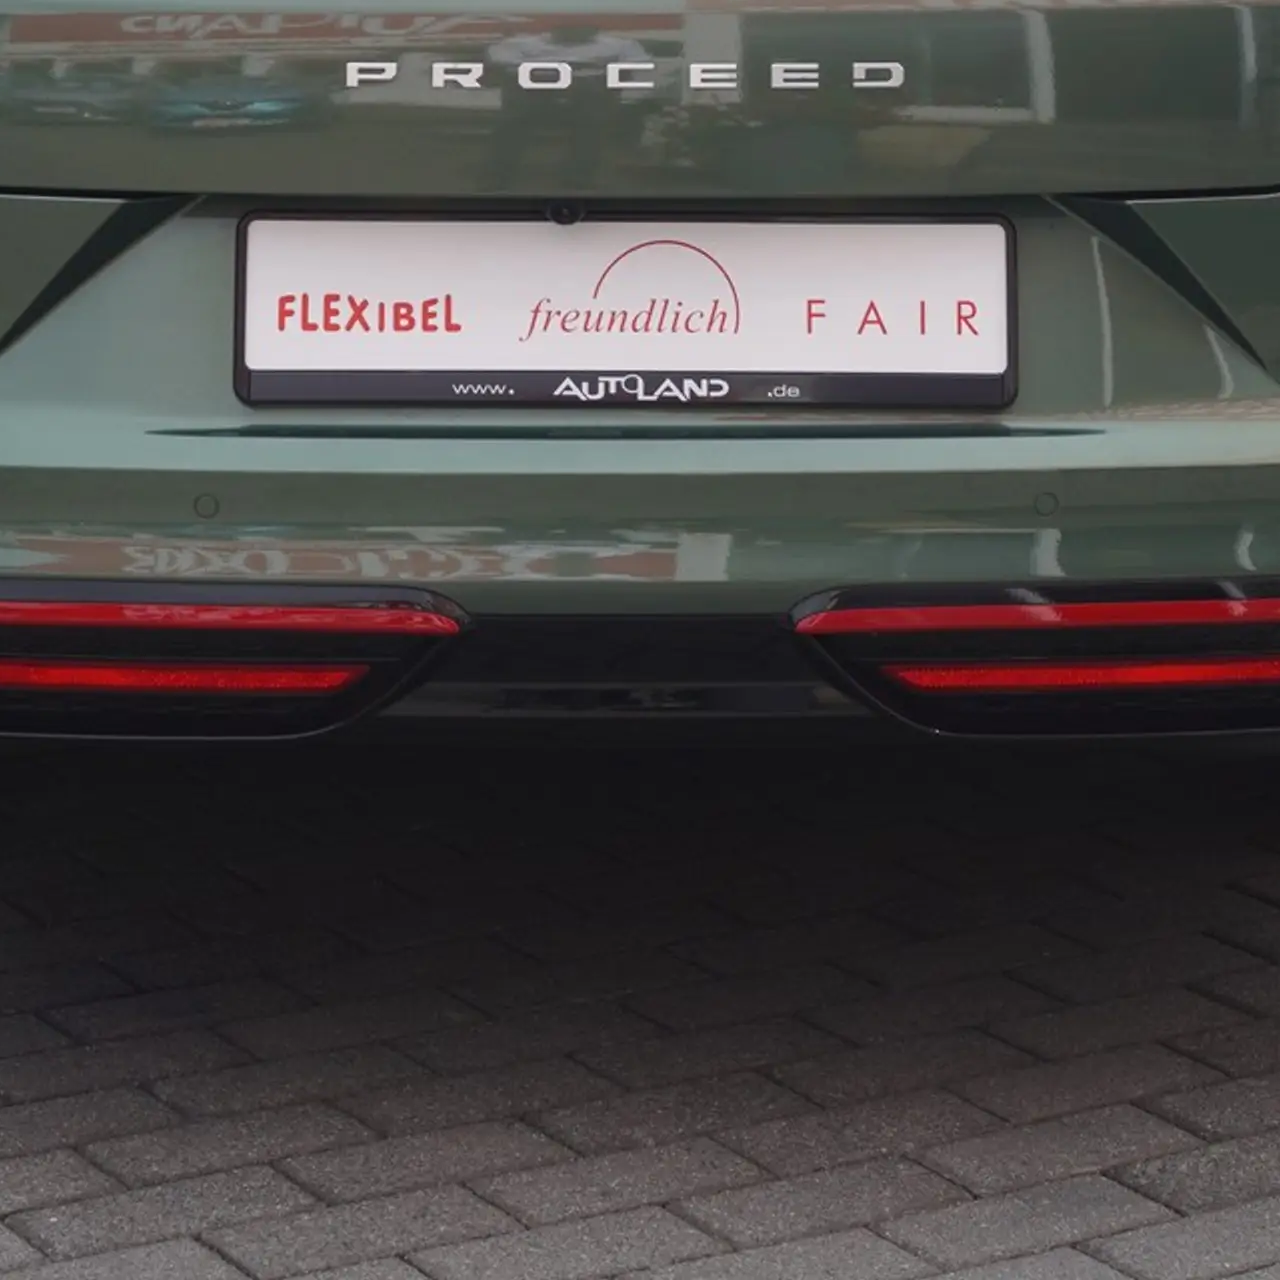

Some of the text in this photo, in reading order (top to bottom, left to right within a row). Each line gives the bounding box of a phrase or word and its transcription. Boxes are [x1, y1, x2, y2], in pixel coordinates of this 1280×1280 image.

[346, 62, 906, 90] PROCEED
[277, 293, 980, 342] FLEXIBEL freundlich FAIR
[452, 374, 801, 401] www. AUTOLAND .de
